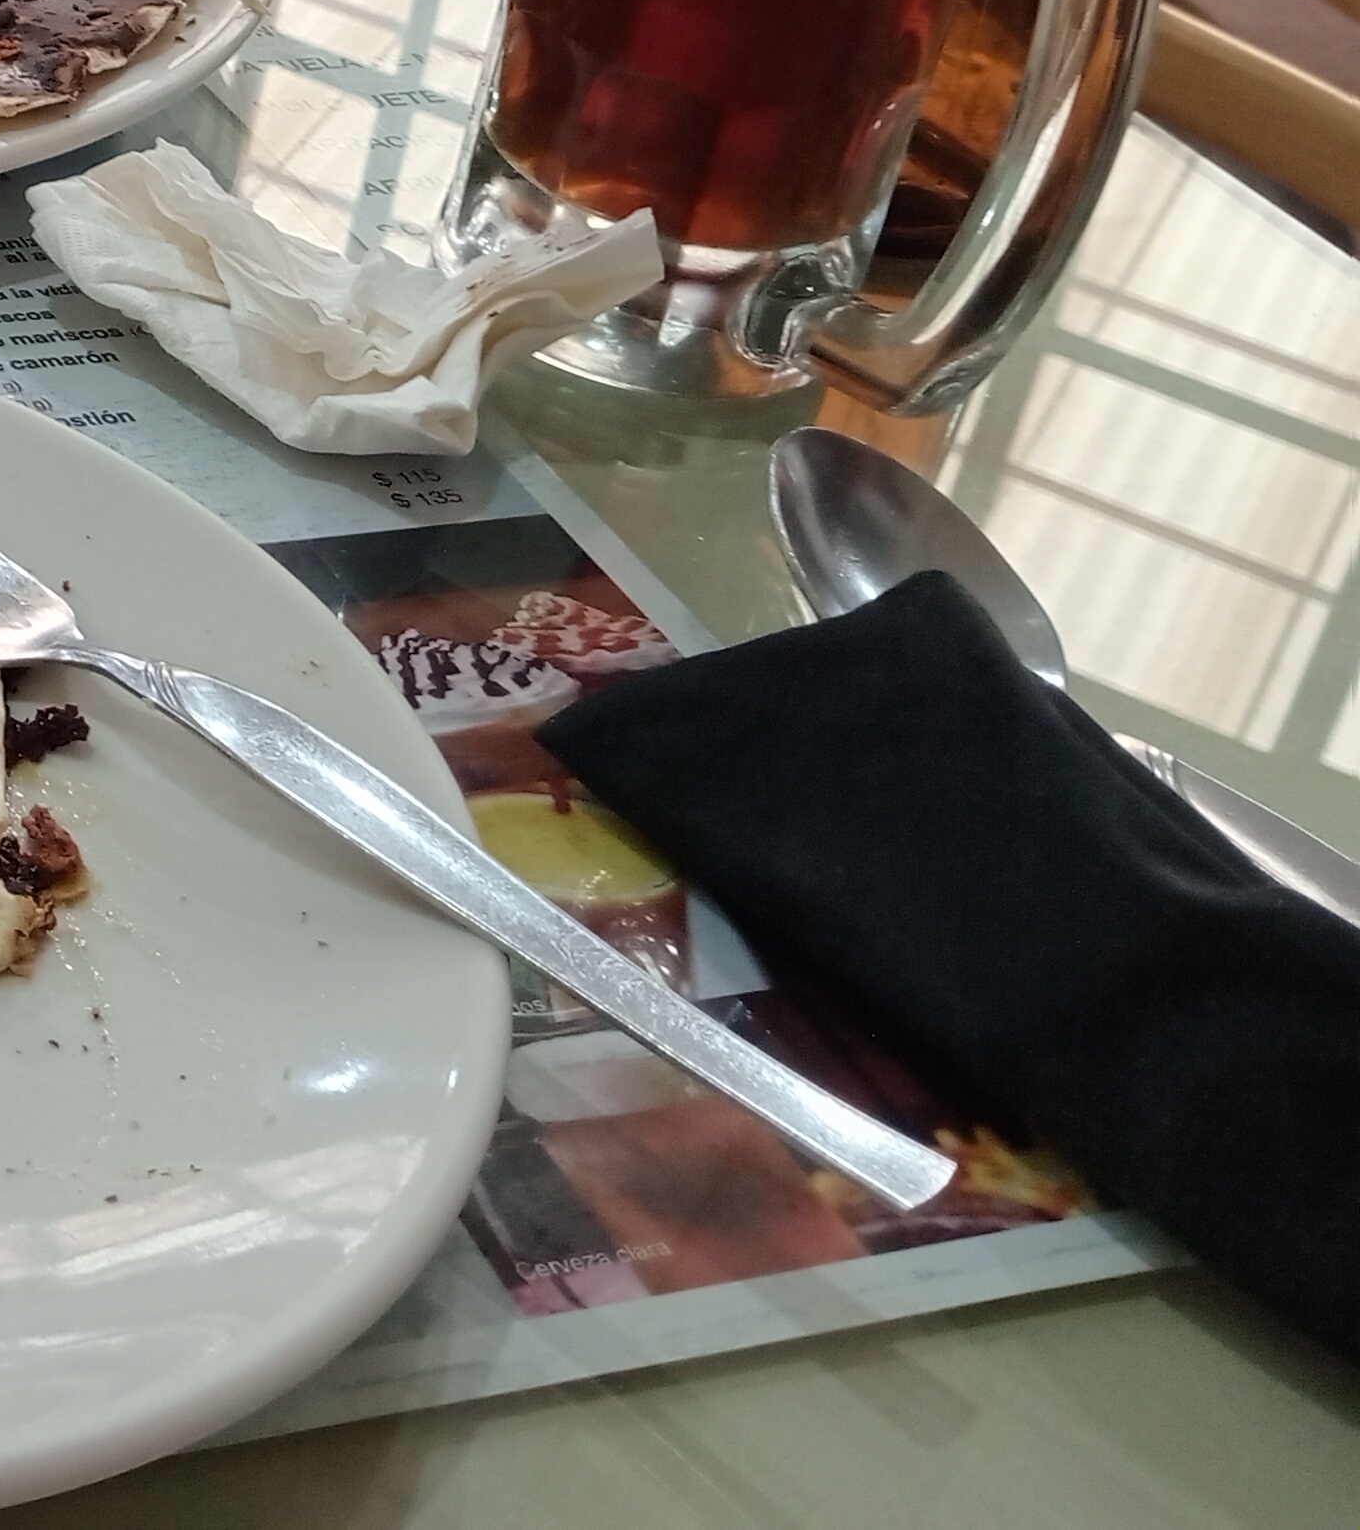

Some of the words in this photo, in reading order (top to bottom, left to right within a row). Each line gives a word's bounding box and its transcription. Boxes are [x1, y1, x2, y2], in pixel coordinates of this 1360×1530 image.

[12, 286, 36, 300] la
[9, 325, 124, 346] mariscos
[8, 350, 121, 372] camarón
[373, 470, 393, 489] $
[391, 491, 411, 510] $
[415, 488, 464, 508] 135
[513, 1247, 610, 1282] Cerveza
[618, 1238, 676, 1265] clara
